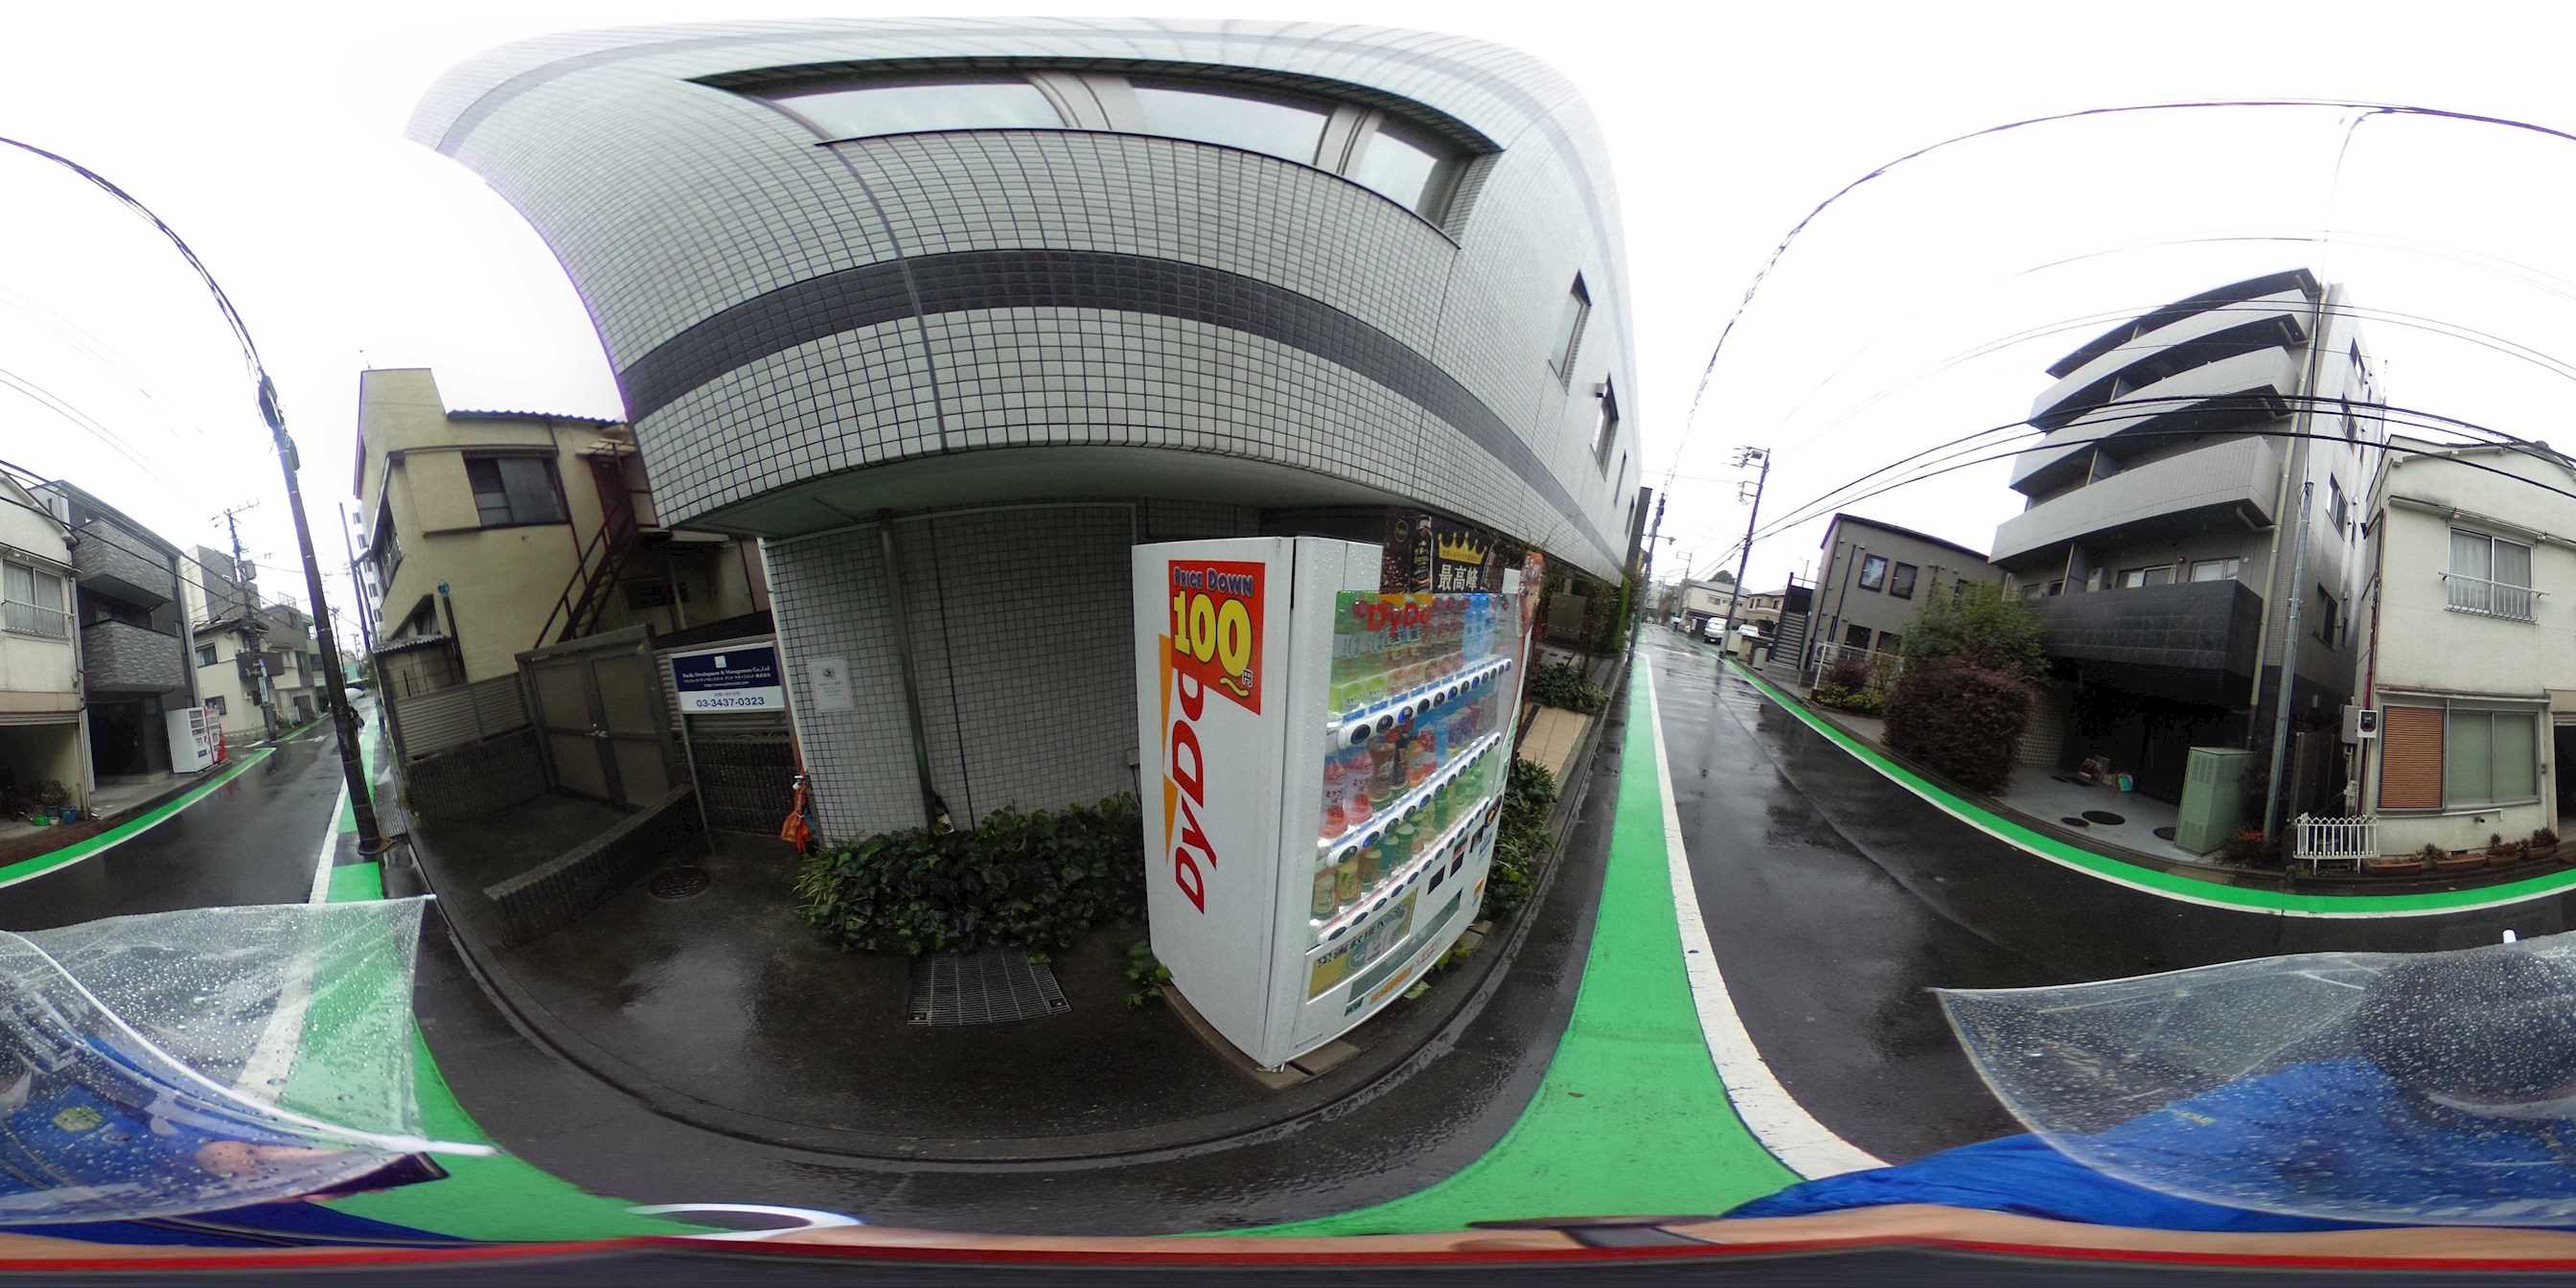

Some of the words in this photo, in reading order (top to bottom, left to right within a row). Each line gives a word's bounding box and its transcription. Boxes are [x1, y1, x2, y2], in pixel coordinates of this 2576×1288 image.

[1438, 564, 1479, 591] 最高峰
[1173, 590, 1253, 678] 100
[696, 697, 765, 707] 03-3437-0323
